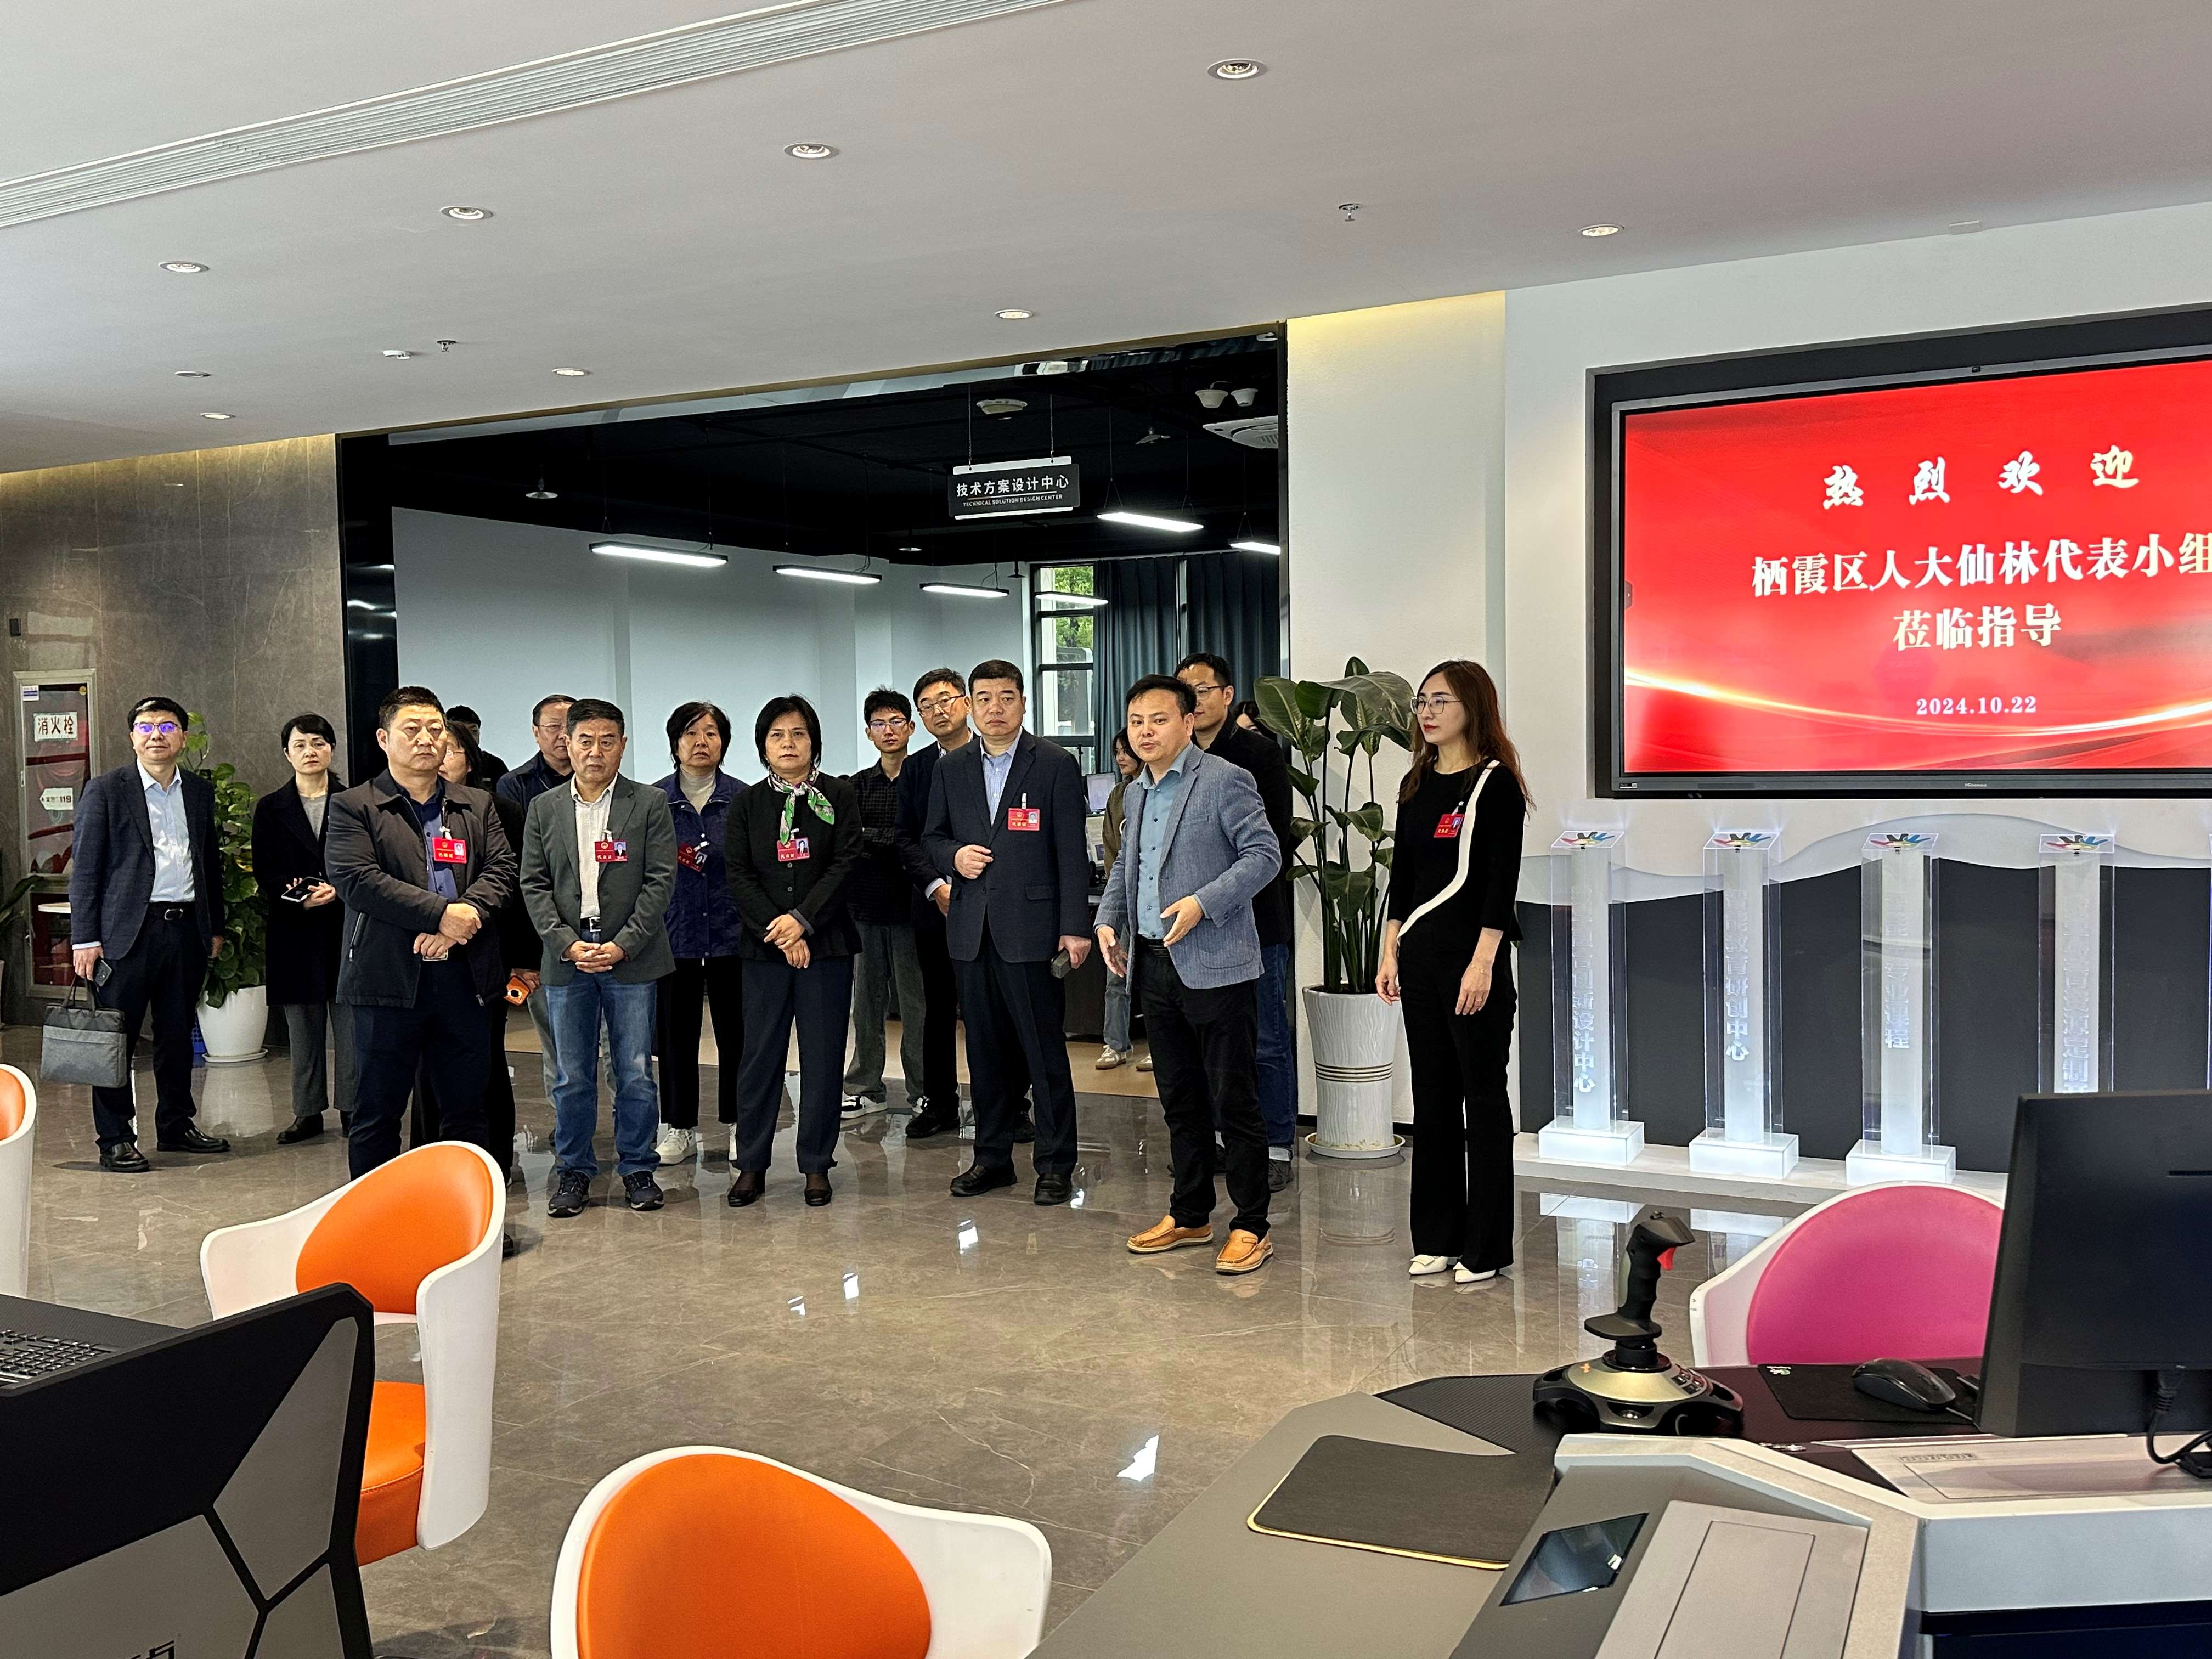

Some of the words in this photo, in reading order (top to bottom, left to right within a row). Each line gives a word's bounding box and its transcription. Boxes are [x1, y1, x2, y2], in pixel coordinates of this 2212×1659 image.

[956, 474, 1069, 498] 技术方案设计中心
[1751, 532, 2212, 597] 栖霞区人大仙林代表小组
[1893, 602, 2062, 651] 莅临指导
[1916, 695, 2036, 715] 2024.10.22
[38, 715, 74, 735] 消火栓
